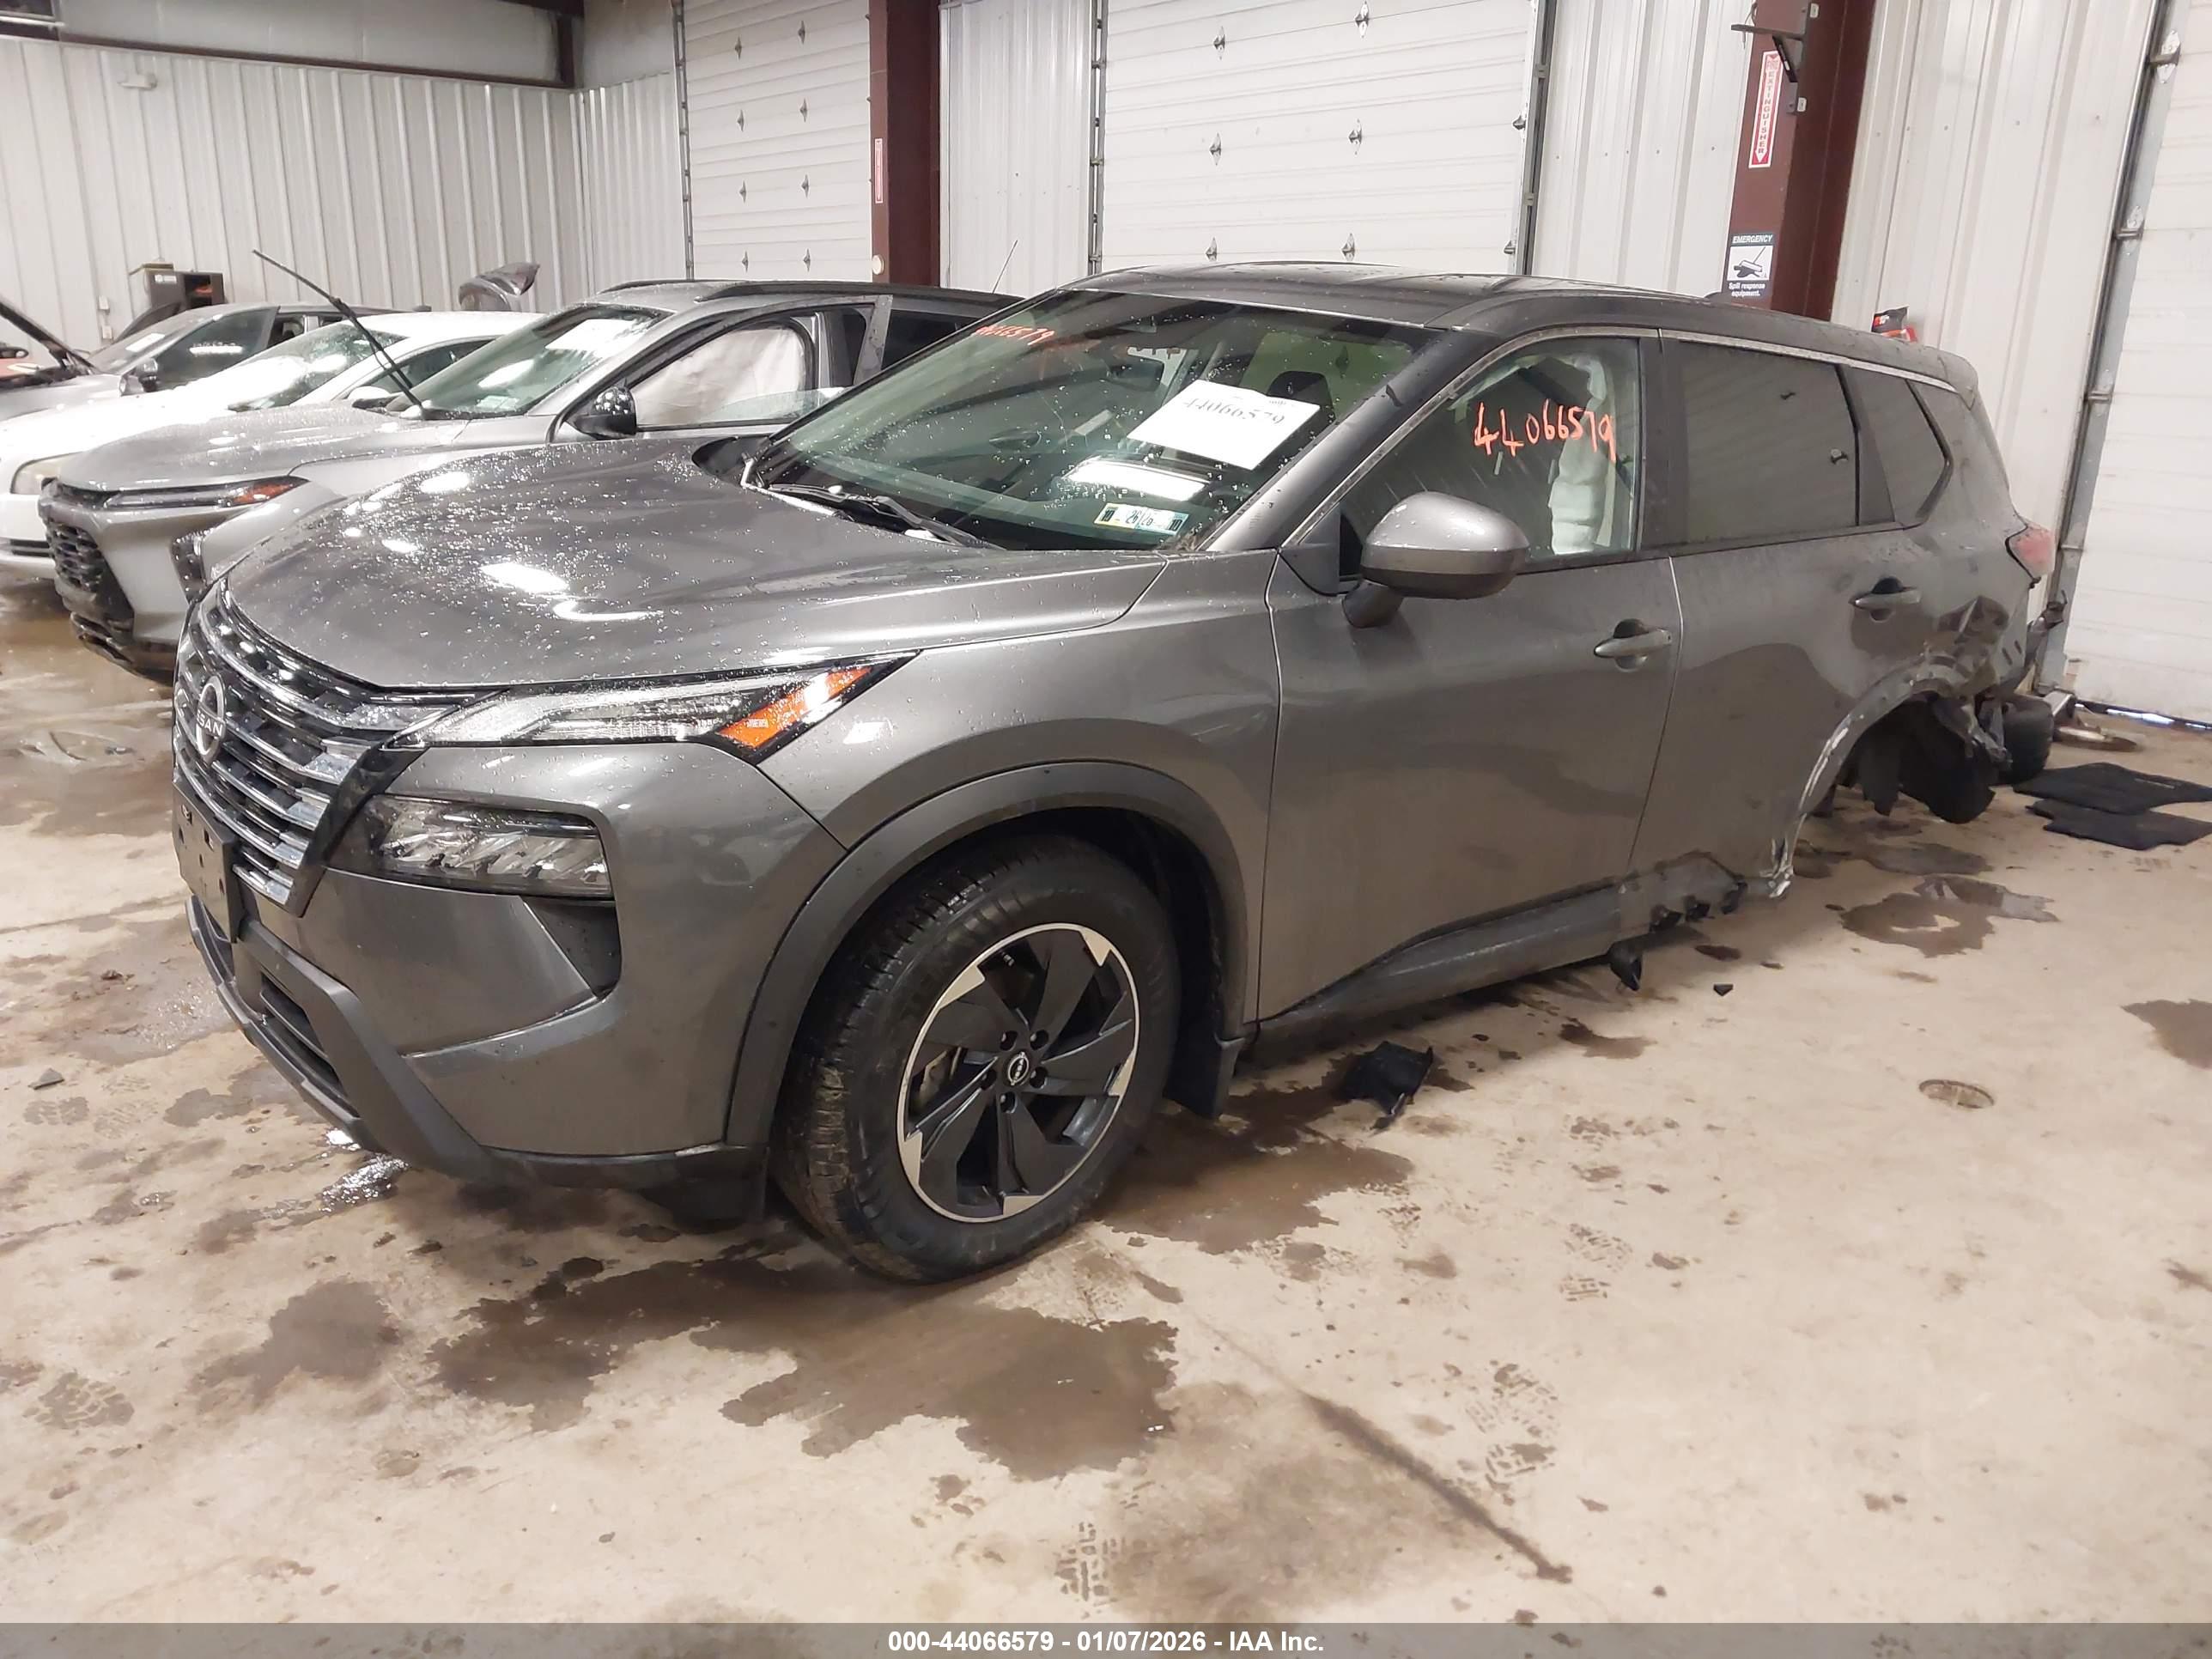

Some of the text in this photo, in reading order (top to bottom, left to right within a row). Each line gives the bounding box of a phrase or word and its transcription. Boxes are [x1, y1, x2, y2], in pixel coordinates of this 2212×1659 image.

[1758, 70, 1776, 154] EXTINGUISHER
[1731, 234, 1773, 244] EMERGENCY
[1474, 398, 1617, 463] 44066579
[1169, 519, 1183, 532] 10
